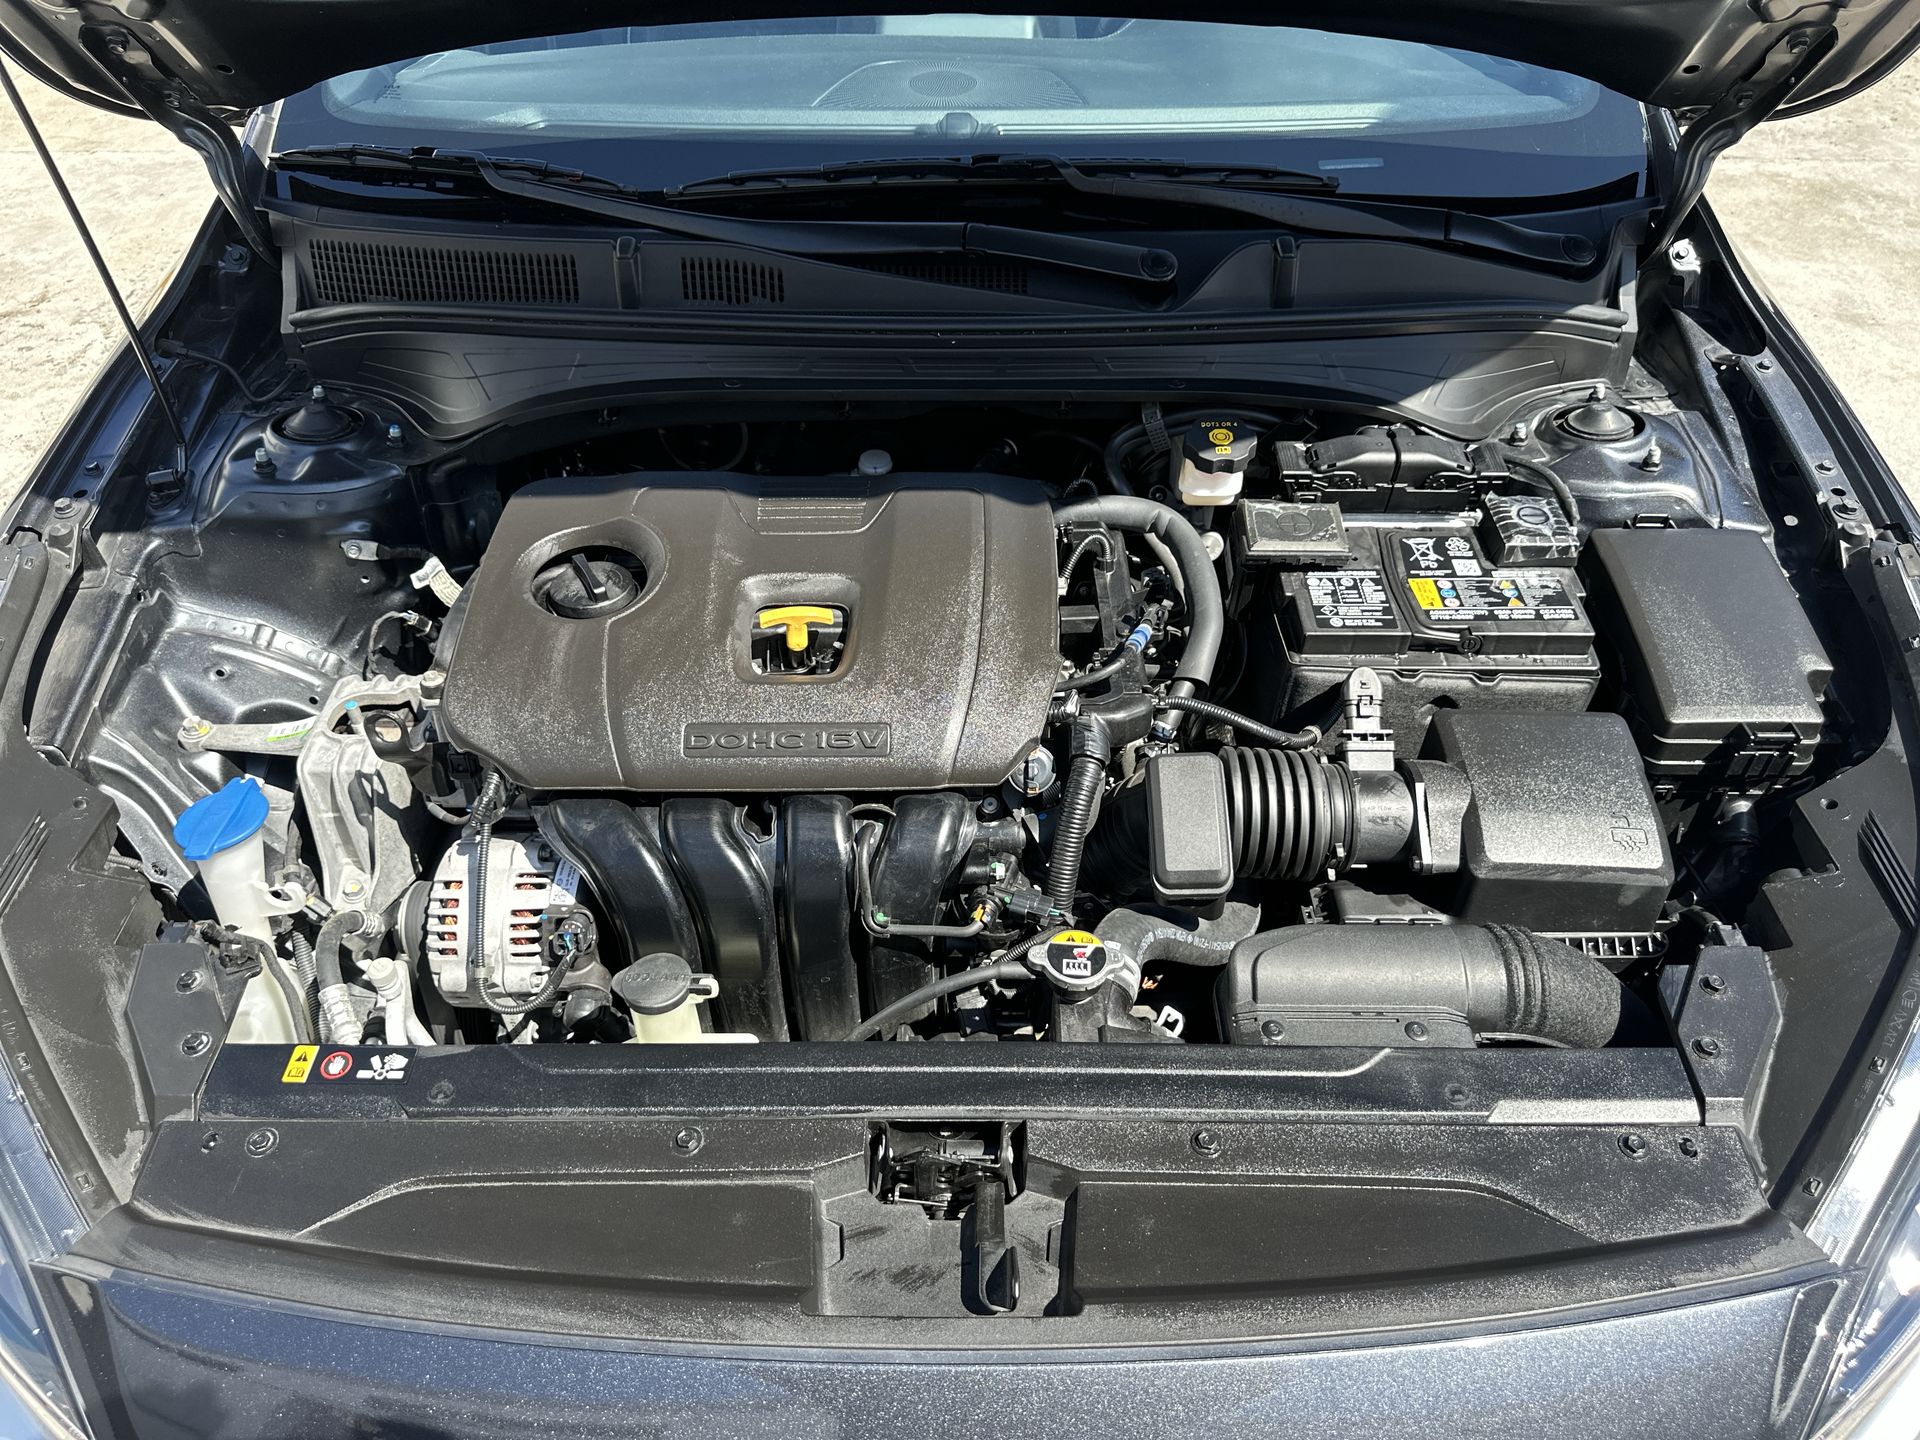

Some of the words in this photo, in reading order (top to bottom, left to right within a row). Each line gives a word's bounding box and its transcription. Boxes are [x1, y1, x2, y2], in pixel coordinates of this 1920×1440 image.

[1420, 560, 1438, 568] Pb
[686, 729, 805, 750] DOHC
[816, 729, 886, 750] 16V
[1110, 952, 1121, 961] 1.1
